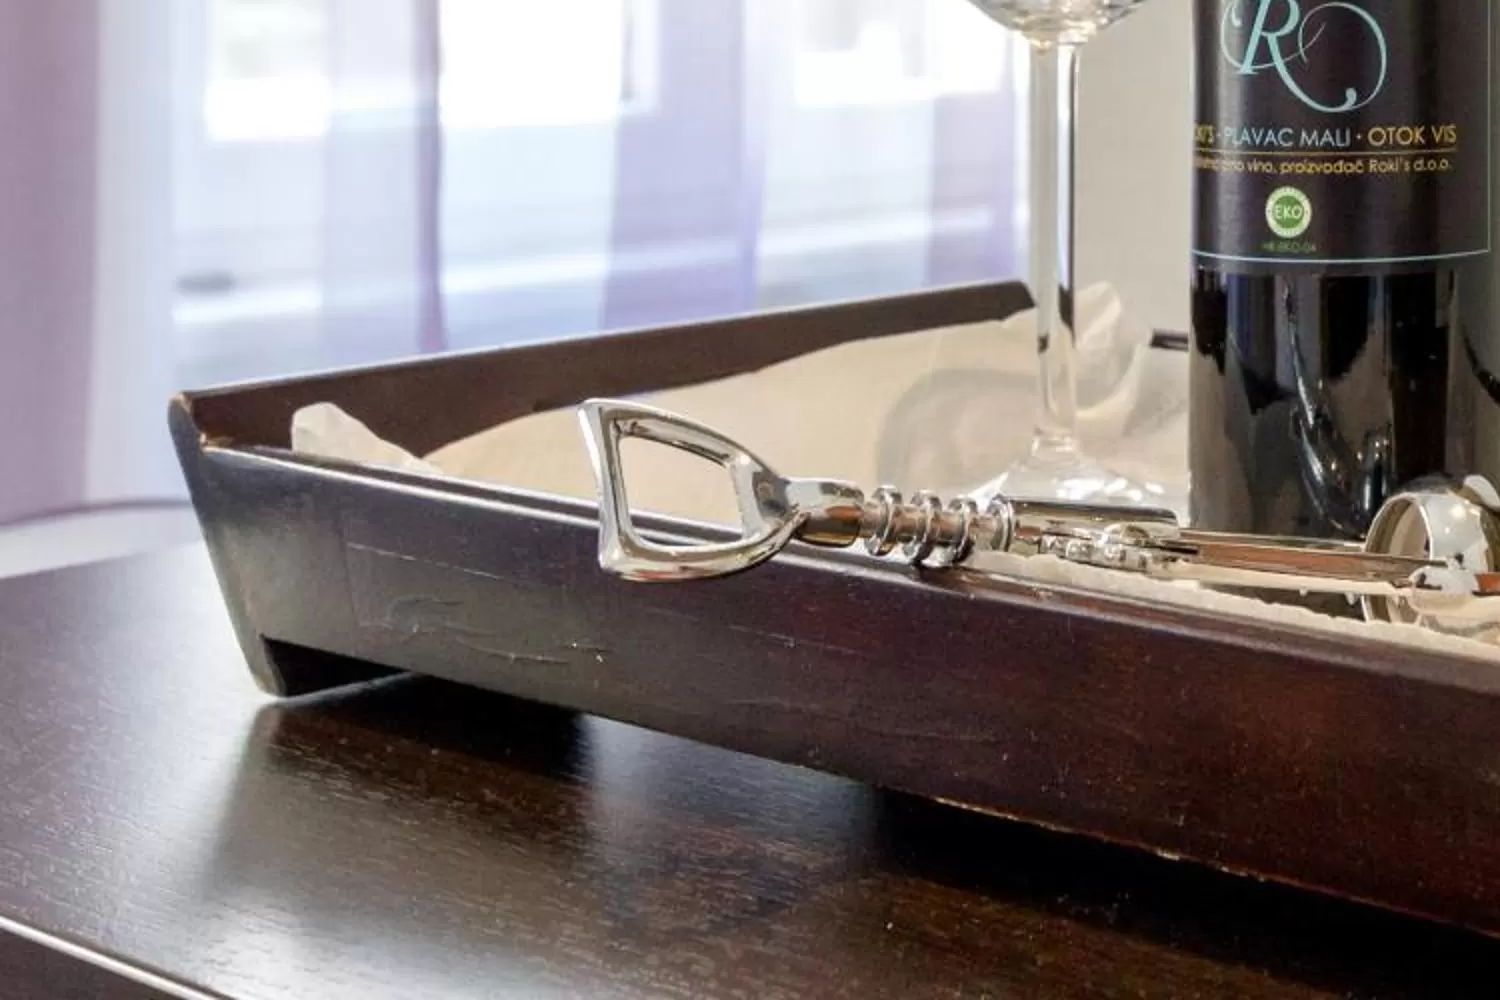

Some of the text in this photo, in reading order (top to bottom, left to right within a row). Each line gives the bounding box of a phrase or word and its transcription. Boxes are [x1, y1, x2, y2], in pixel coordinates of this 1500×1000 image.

[1223, 126, 1294, 147] PLAVAC
[1299, 127, 1351, 147] MALI
[1367, 126, 1426, 147] OTOK
